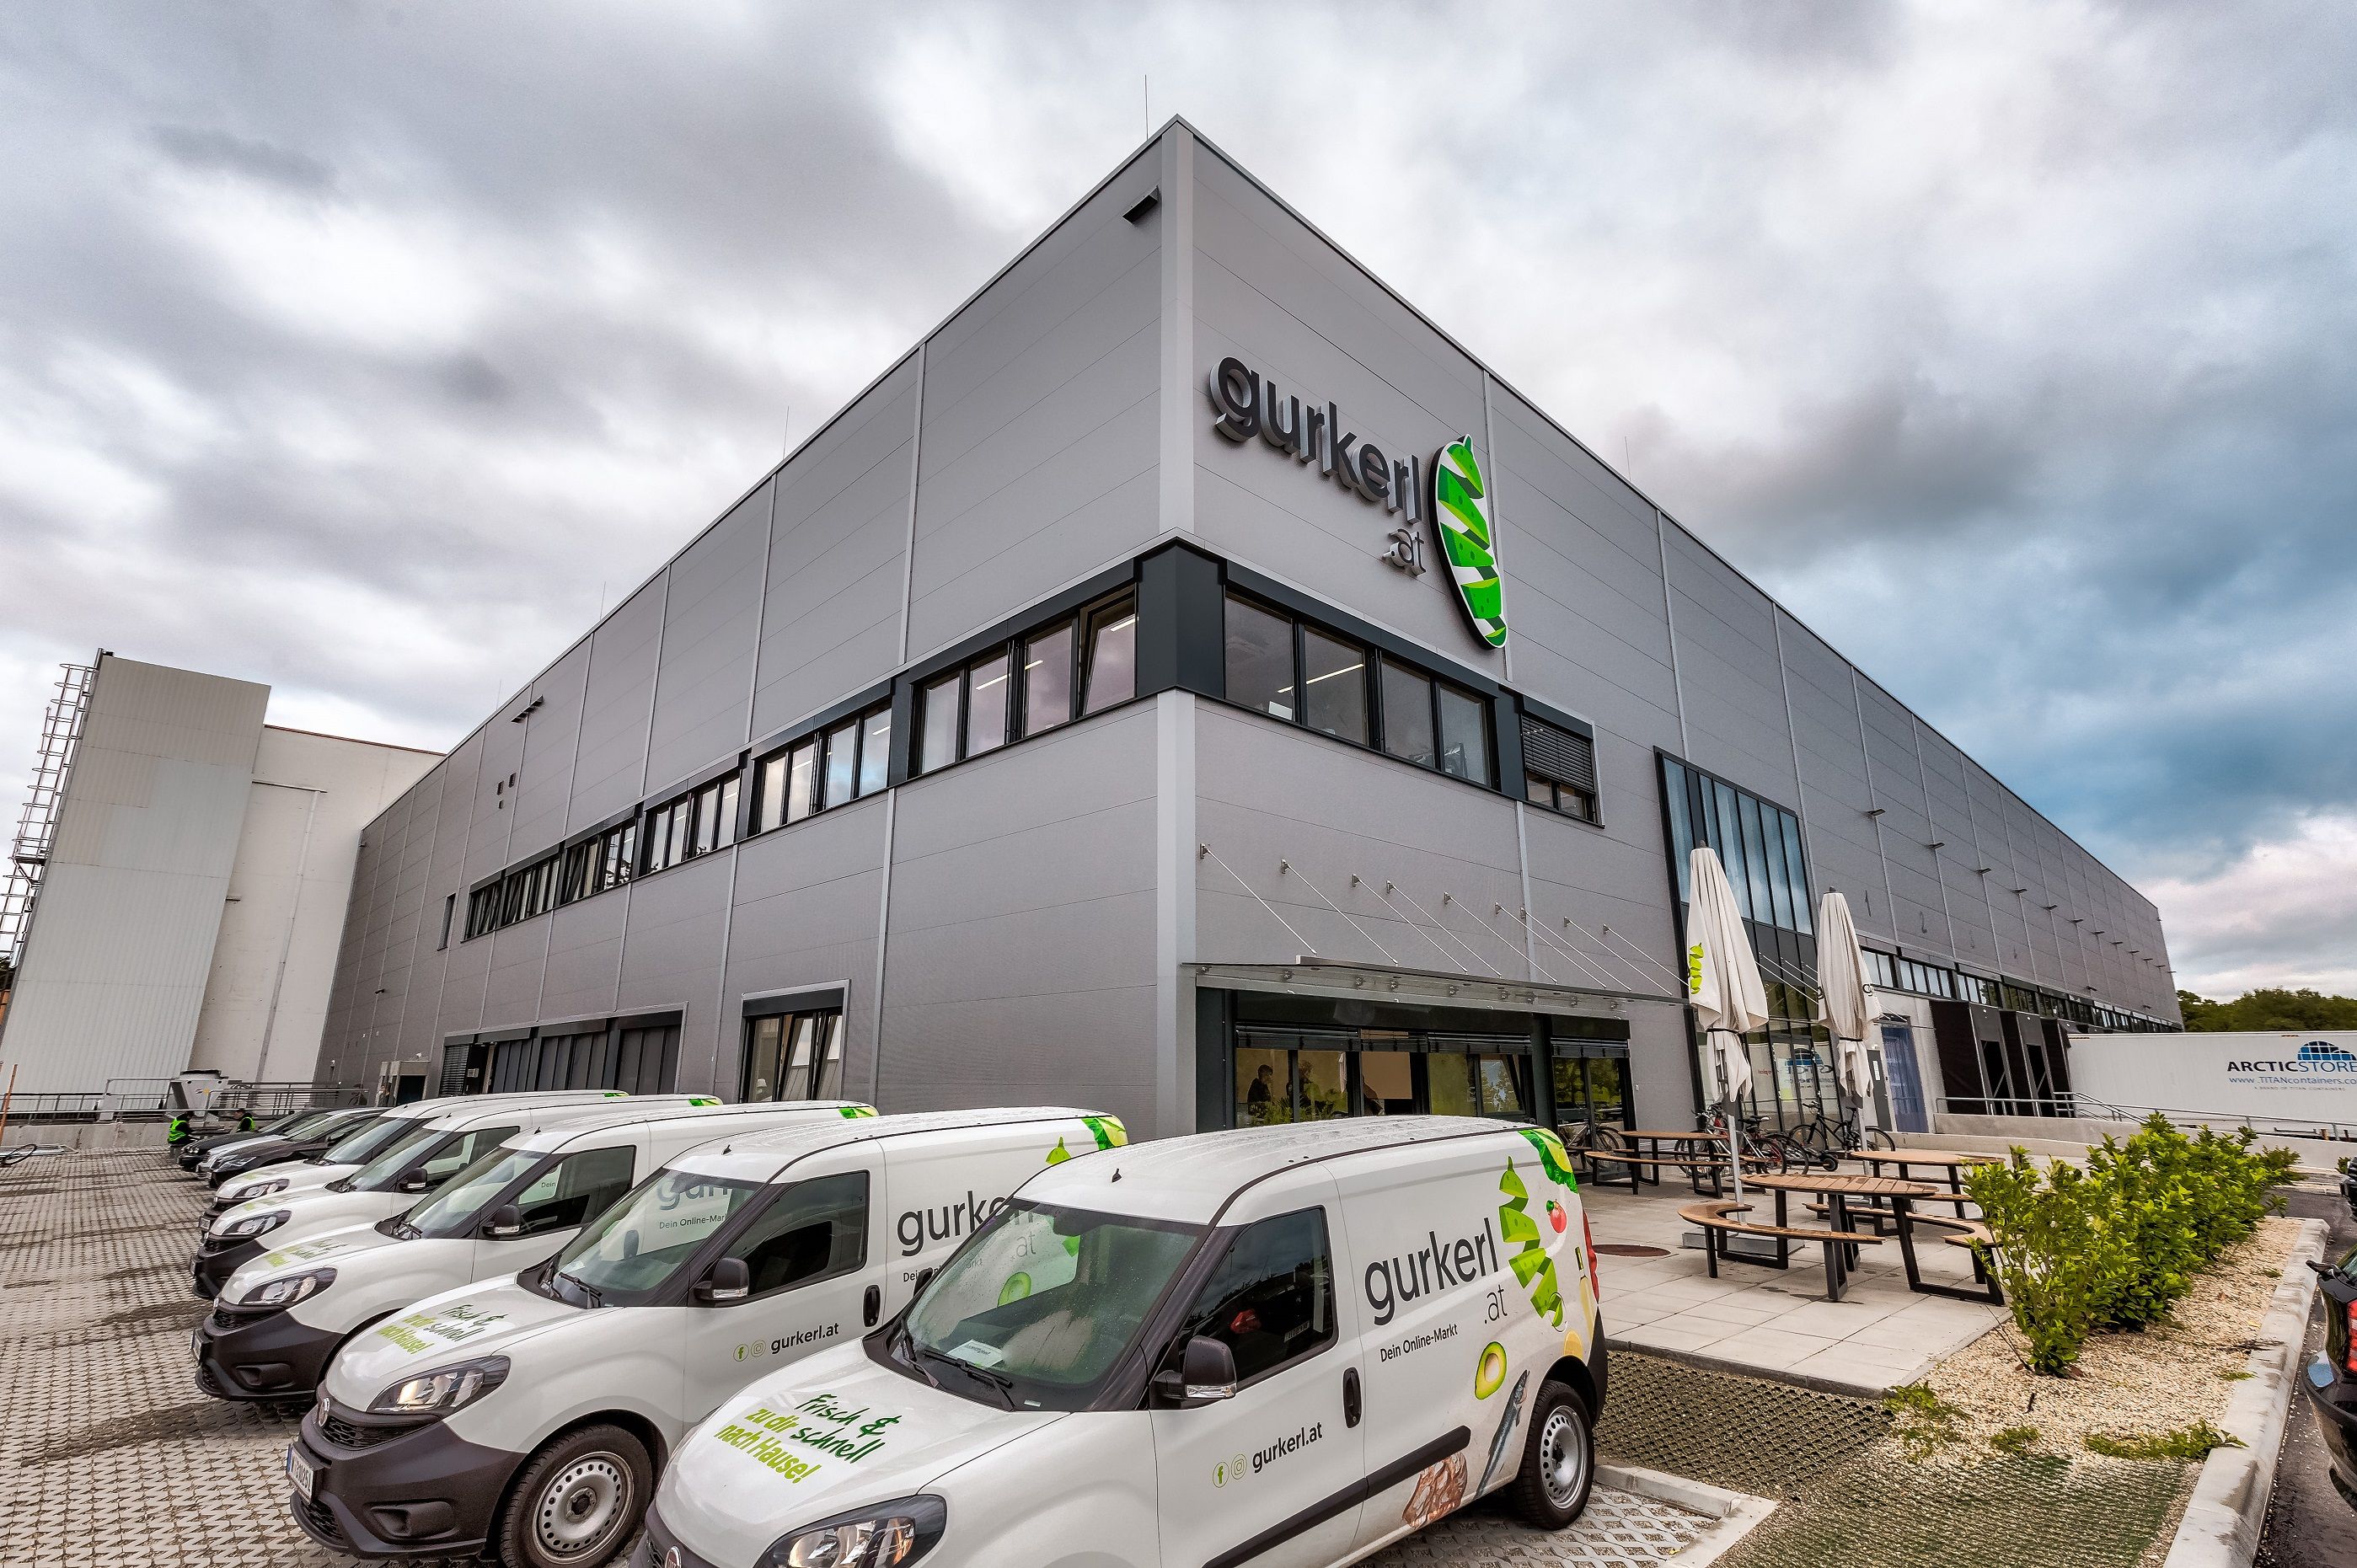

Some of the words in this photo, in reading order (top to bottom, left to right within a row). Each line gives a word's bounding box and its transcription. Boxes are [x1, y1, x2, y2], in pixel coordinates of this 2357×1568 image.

[1210, 356, 1422, 524] gurkerl
[1383, 528, 1426, 575] .at
[659, 1220, 678, 1229] Dein
[679, 1214, 726, 1227] Online-Mar
[897, 1190, 1033, 1257] gurk
[903, 1270, 919, 1283] Dei
[1364, 1217, 1498, 1326] gurkerl
[1484, 1284, 1508, 1325] .at
[770, 1322, 839, 1355] gurkerl.at
[1380, 1344, 1402, 1362] Dein
[1402, 1324, 1459, 1354] Online-Markt
[745, 1408, 776, 1425] zu
[763, 1415, 801, 1433] dir
[794, 1394, 870, 1426] Frisch
[856, 1415, 903, 1438] &
[714, 1424, 764, 1450] nach
[747, 1437, 822, 1484] Hause!
[789, 1427, 886, 1464] schnell
[1252, 1421, 1323, 1474] gurkerl.at
